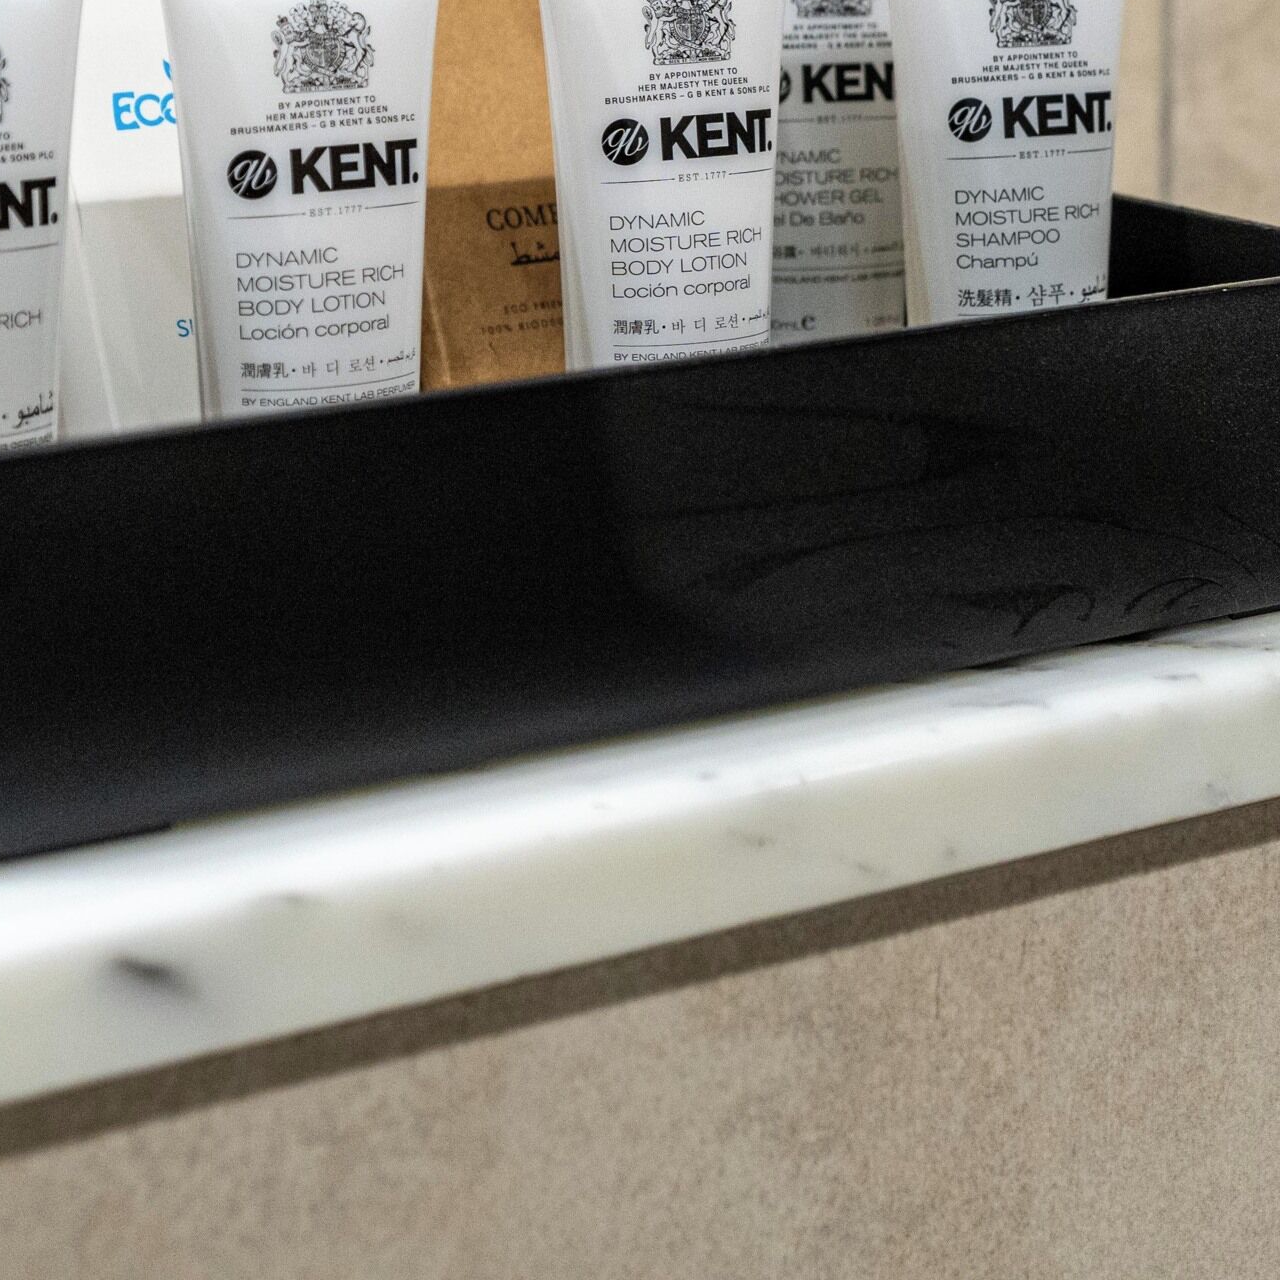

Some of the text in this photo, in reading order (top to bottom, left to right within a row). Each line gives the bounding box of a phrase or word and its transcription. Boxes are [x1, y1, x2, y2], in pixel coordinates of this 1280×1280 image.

[993, 50, 1078, 63] BY APPOINTMENT TO
[649, 67, 738, 81] BY APPOINTMENT TO
[982, 60, 1089, 73] HER MAJESTY THE QUEEN
[638, 76, 748, 92] HER MAJESTY THE QUEEN
[801, 60, 894, 103] KEN
[951, 73, 1019, 85] BRUSHMAKERS
[1028, 73, 1035, 81] G
[1037, 72, 1043, 80] B
[1046, 71, 1067, 79] KENT
[1069, 70, 1075, 78] &
[1077, 69, 1097, 78] SONS
[278, 94, 376, 110] BY APPOINTMENT TO
[604, 85, 770, 105] BRUSHMAKERS G B KENT & SONS PLC
[265, 105, 388, 122] HER MAJESTY THE QUEEN
[230, 113, 416, 136] BRUSHMAKERS G B KENT & SONS PLC
[10, 152, 35, 163] SONS
[38, 150, 54, 160] PLC
[776, 148, 841, 164] NAMIC
[774, 168, 855, 186] OISTURE
[774, 189, 845, 207] HOWER
[955, 185, 1045, 205] DYNAMIC
[609, 210, 705, 231] DYNAMIC
[955, 203, 1100, 226] MOISTURE RICH
[610, 227, 762, 253] MOISTURE RICH
[956, 228, 1061, 248] SHAMPOO
[235, 246, 339, 269] DYNAMIC
[611, 251, 747, 276] BODY LOTION
[956, 252, 1039, 271] Champú
[237, 263, 404, 293] MOISTURE RICH
[612, 282, 678, 299] Loción
[683, 274, 751, 297] corporal
[238, 290, 386, 317] BODY LOTION
[239, 314, 390, 341] Loción corporal
[614, 353, 629, 361] BY
[631, 351, 687, 362] ENGLAND
[241, 397, 256, 406] BY
[259, 396, 318, 407] ENGLAND
[321, 393, 351, 404] KENT
[354, 390, 374, 401] LAB
